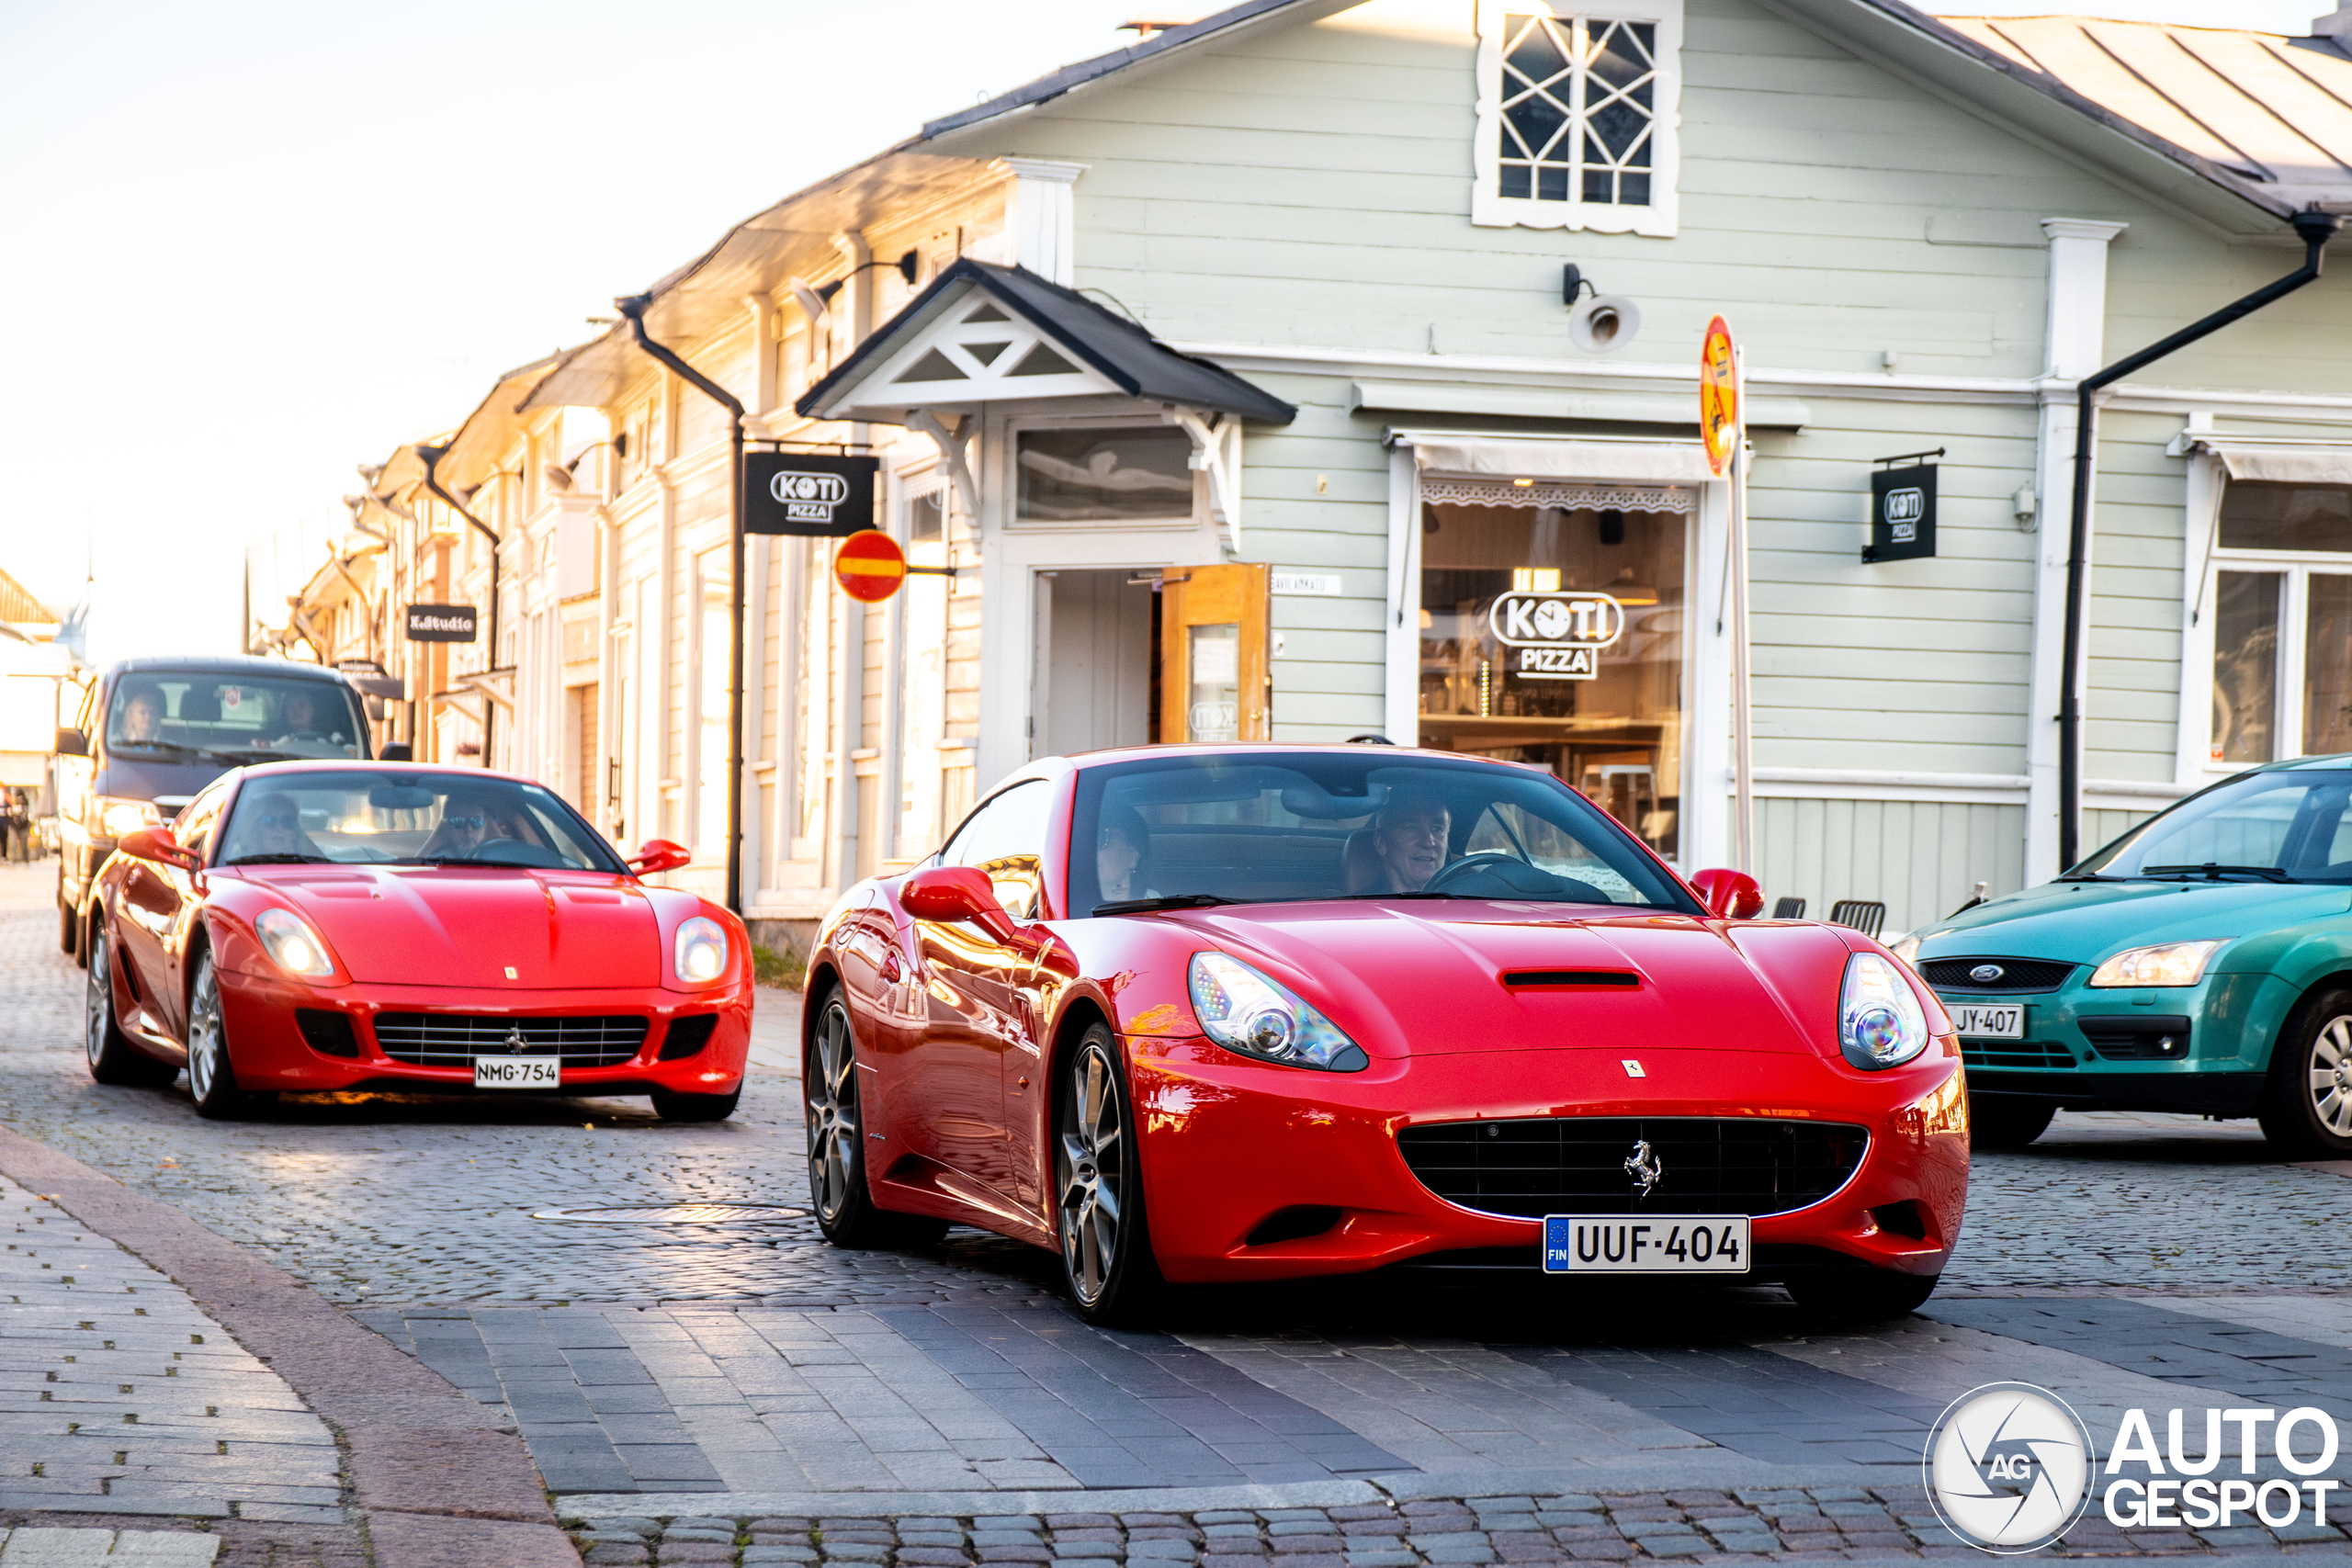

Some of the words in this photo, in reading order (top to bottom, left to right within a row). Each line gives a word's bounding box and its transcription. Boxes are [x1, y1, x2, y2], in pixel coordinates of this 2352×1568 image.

[780, 476, 838, 501] KOTI
[787, 503, 827, 518] PIZZA
[1507, 598, 1608, 640] KOTI
[1521, 649, 1589, 672] PIZZA
[478, 1064, 555, 1080] NMG-754
[1548, 1249, 1567, 1261] FIN
[1577, 1225, 1739, 1263] UUF-404
